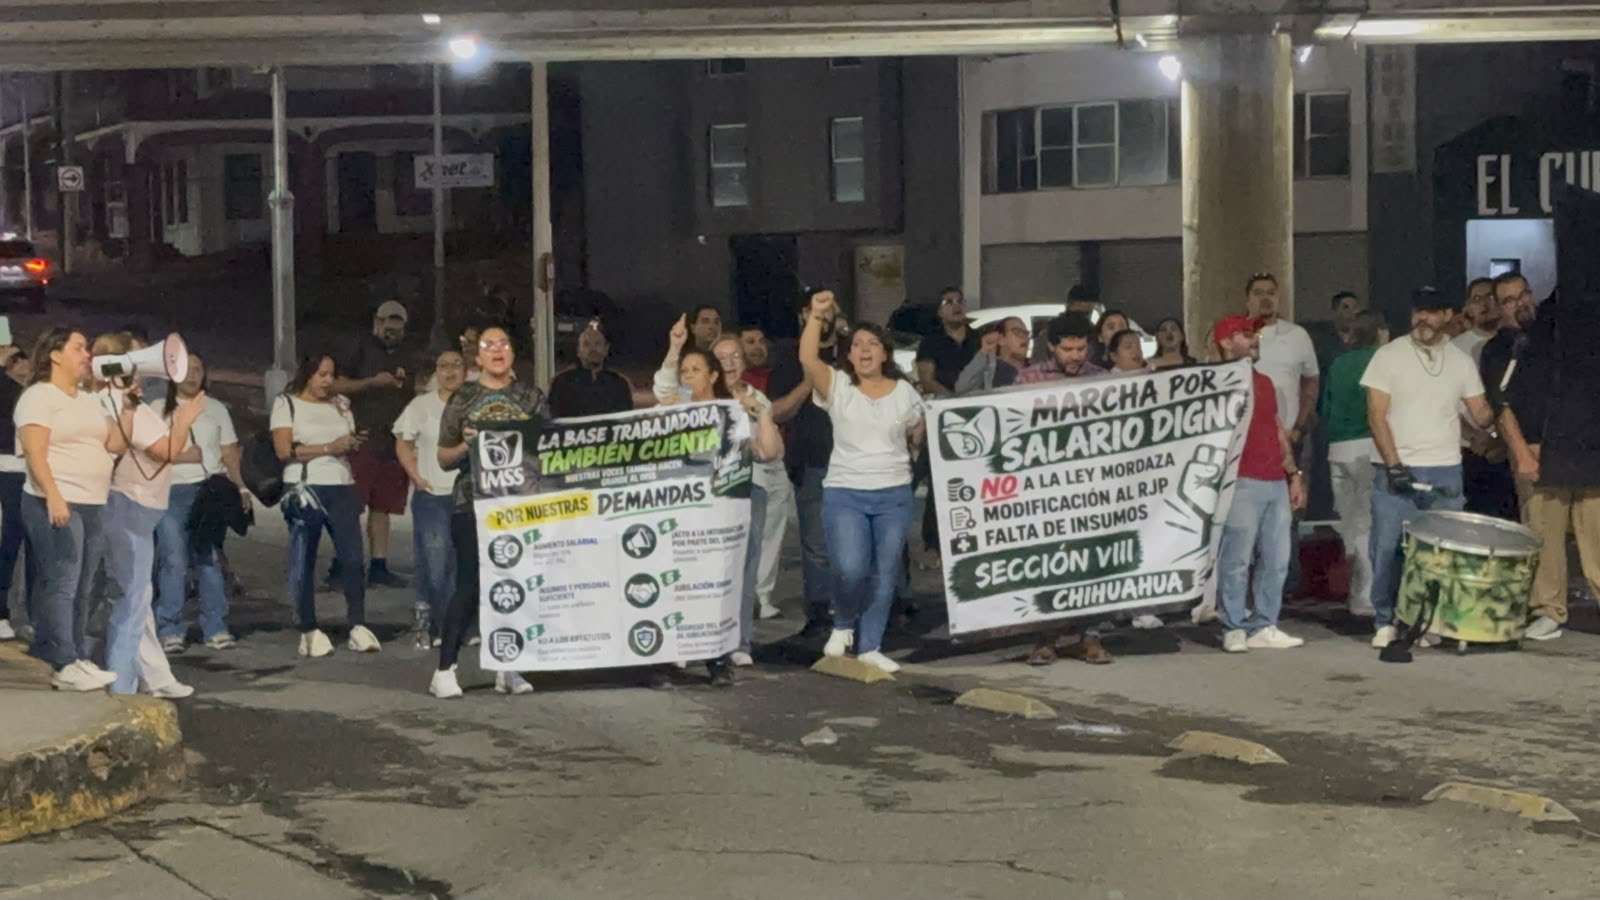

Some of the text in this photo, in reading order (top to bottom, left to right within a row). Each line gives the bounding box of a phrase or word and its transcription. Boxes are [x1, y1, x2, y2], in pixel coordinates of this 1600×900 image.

[1477, 154, 1519, 215] EL
[1031, 369, 1217, 427] MARCHA POR
[537, 405, 721, 451] LA BASE TRABAJADORA
[1001, 416, 1144, 473] SALARIO
[538, 427, 722, 476] TAMBIÉN CUENTA
[481, 467, 525, 490] IMSS
[980, 453, 1175, 499] NO A LA LEY MORDAZA
[496, 482, 706, 526] POR NUESTRAS DEMANDAS
[983, 477, 1169, 523] MODIFICACIÓN AL RJP
[985, 504, 1148, 547] FALTA DE INSUMOS
[975, 538, 1134, 589] SECCIÓN VIII
[1052, 572, 1184, 610] CHIHUAHUA
